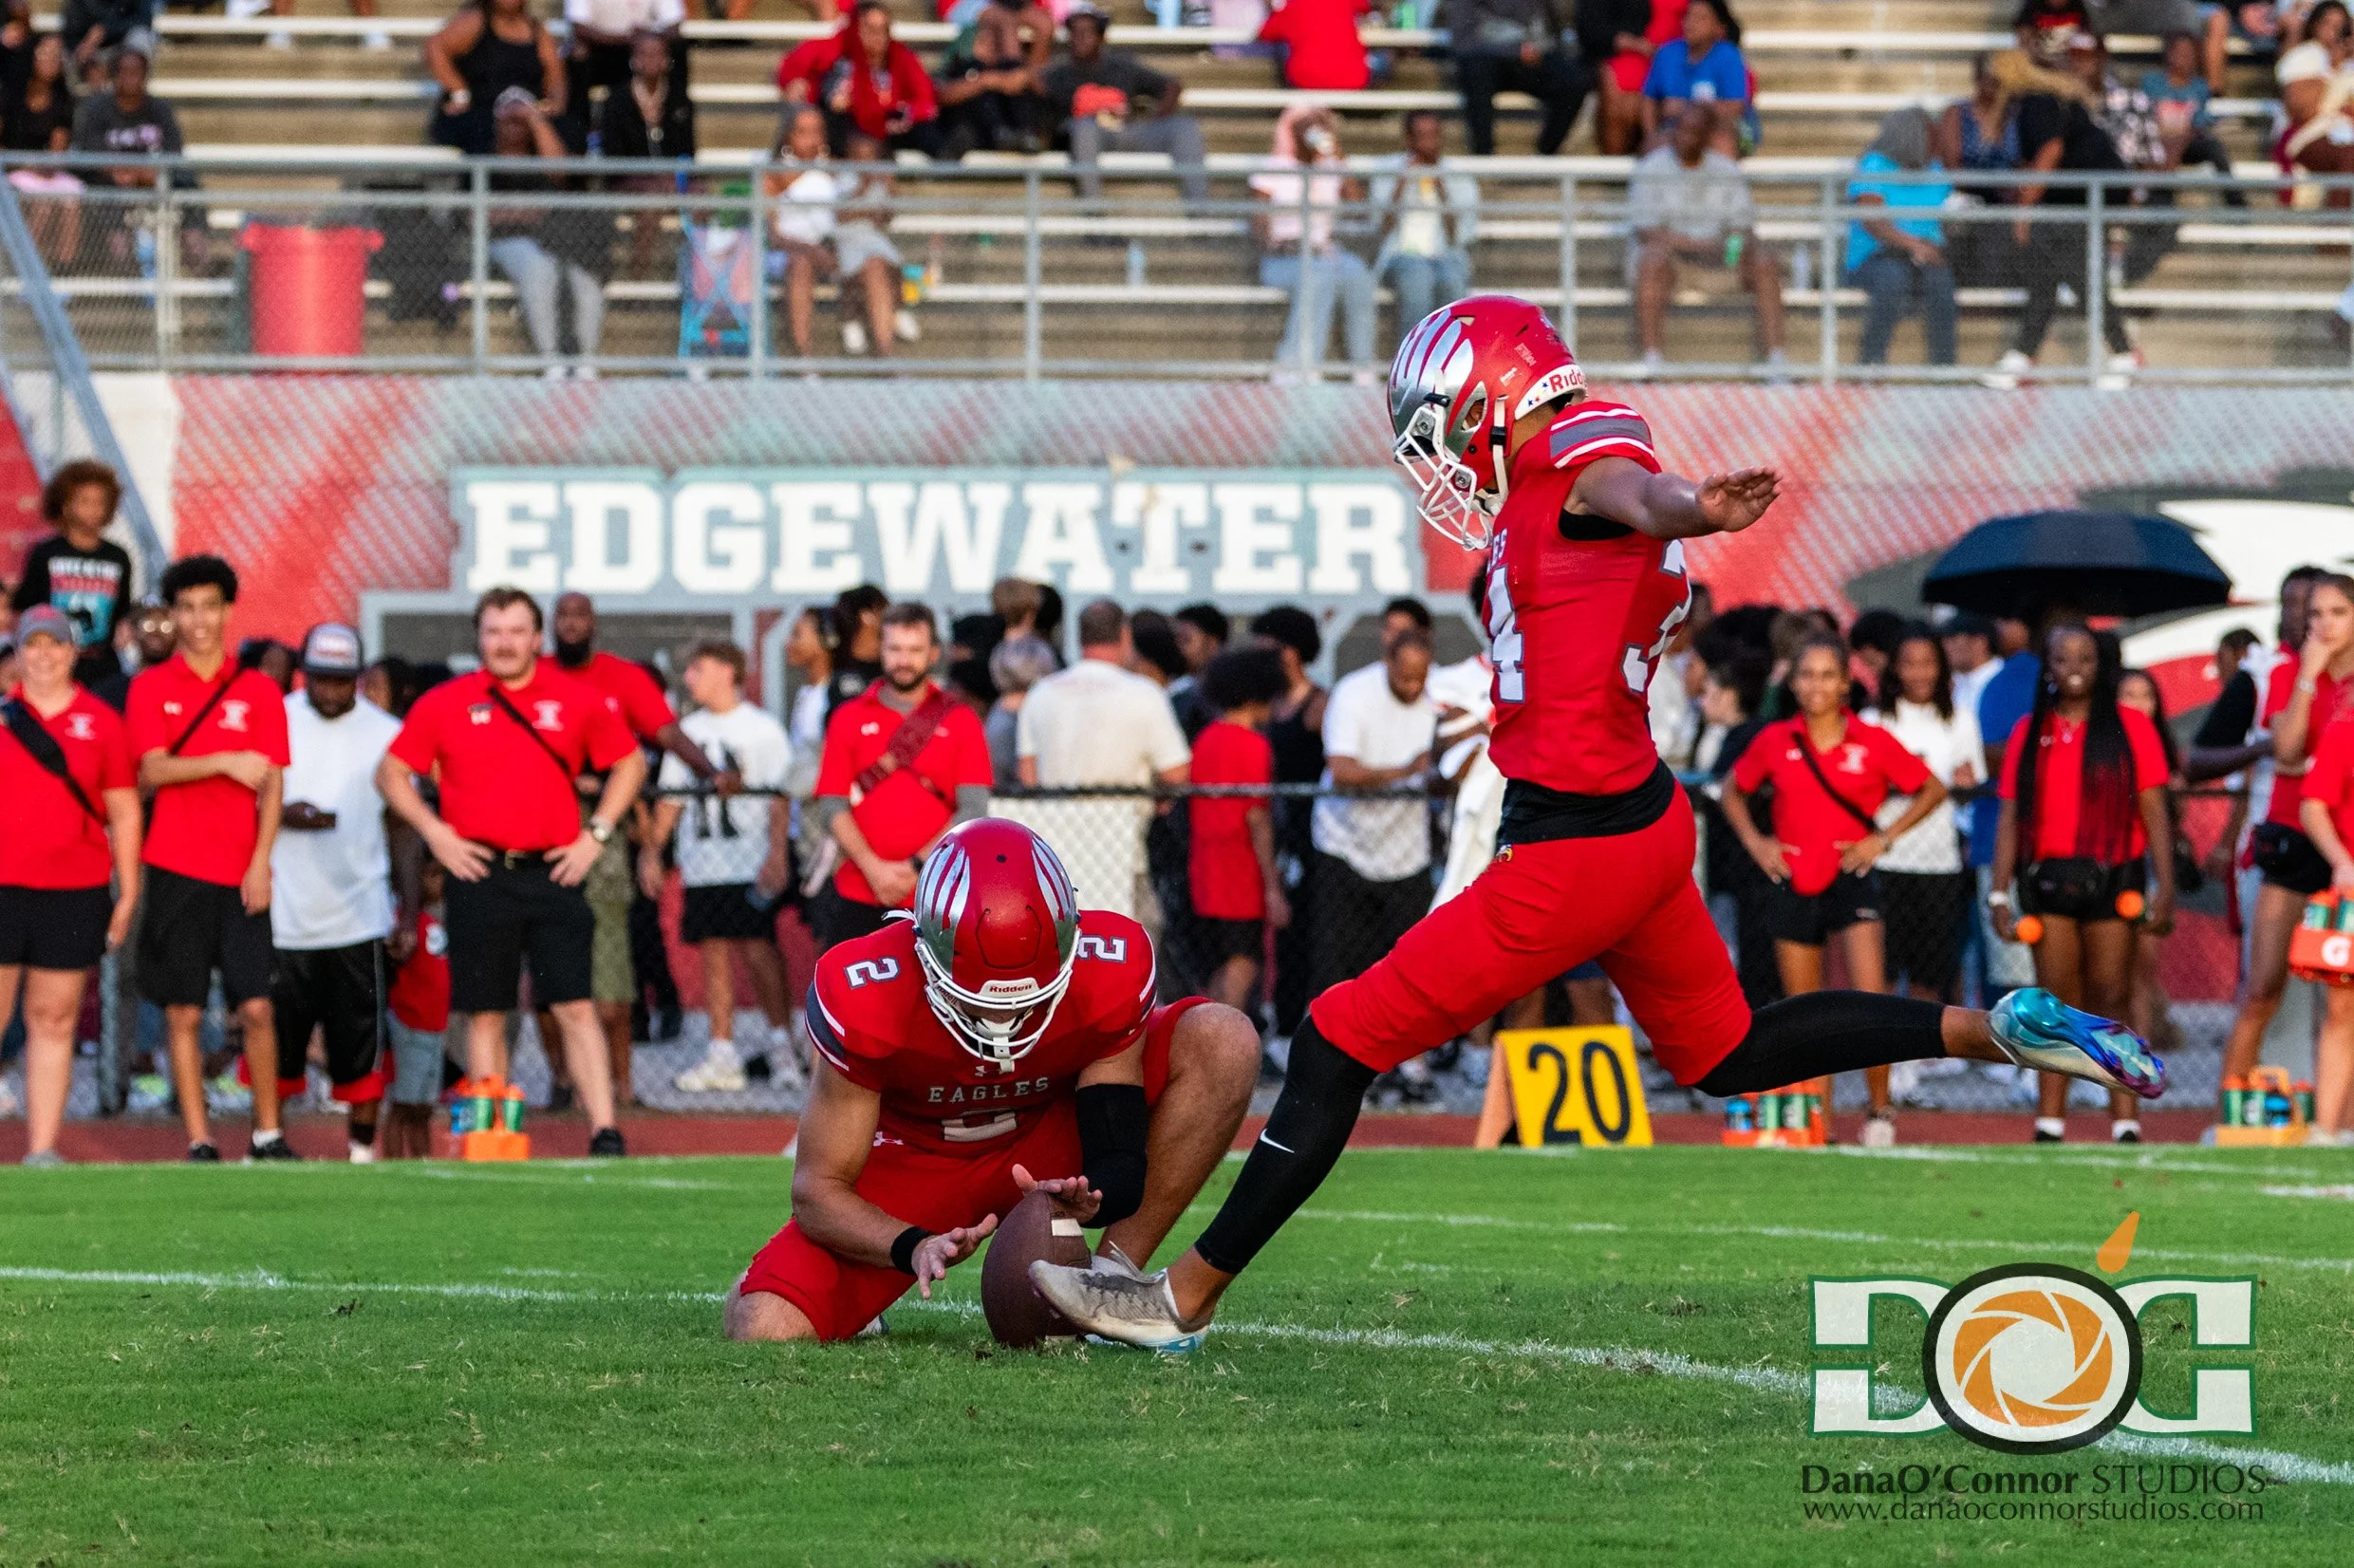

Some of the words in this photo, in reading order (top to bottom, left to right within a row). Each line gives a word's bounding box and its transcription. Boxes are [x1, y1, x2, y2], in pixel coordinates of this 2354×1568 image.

[467, 481, 1411, 593] EDGEWATER
[1074, 935, 1127, 962] 2
[845, 956, 901, 989] 2
[989, 984, 1032, 993] Riddell
[927, 1077, 1049, 1103] EAGLES
[1527, 1041, 1631, 1144] 20
